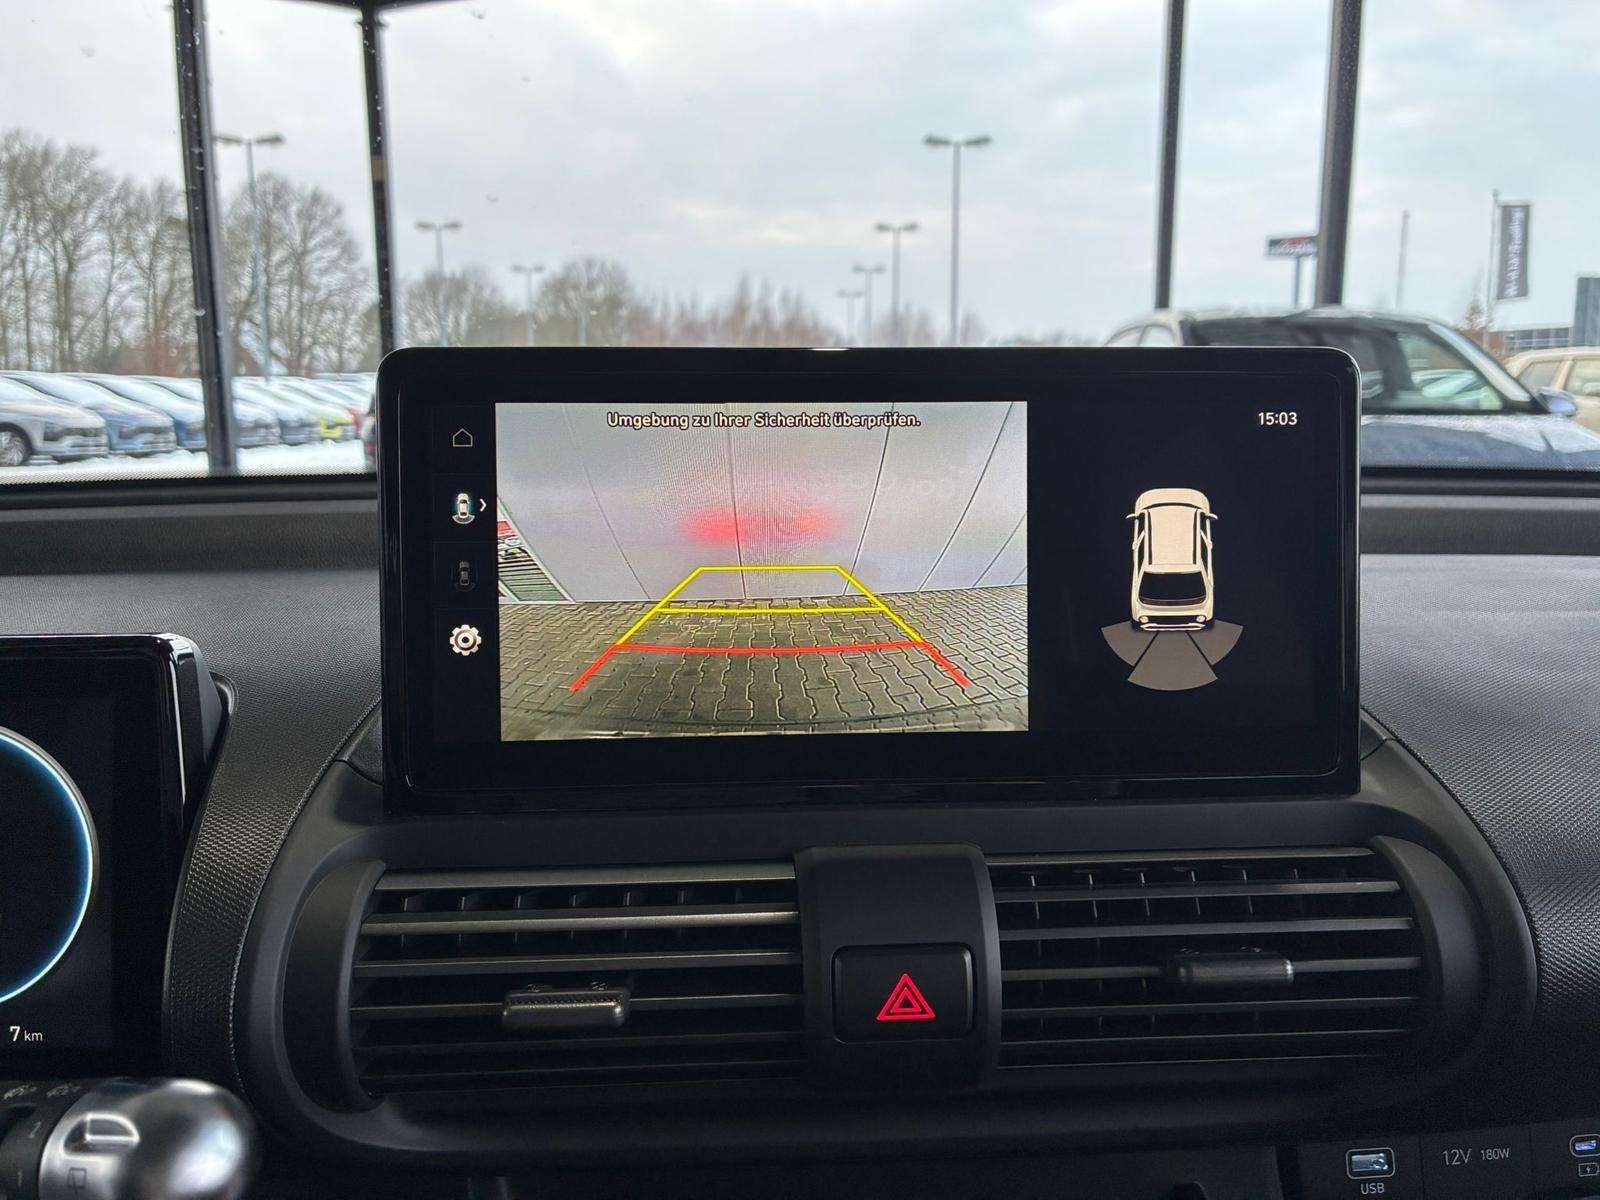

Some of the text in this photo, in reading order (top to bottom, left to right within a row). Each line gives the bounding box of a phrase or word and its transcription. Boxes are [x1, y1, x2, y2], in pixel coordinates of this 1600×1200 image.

[607, 412, 921, 429] Umgebung zu Ihrer Sicherheit überprüfen.
[1258, 411, 1298, 426] 15:03
[9, 1025, 43, 1041] 7 km
[1442, 1148, 1510, 1166] 12V 180W
[1360, 1183, 1385, 1195] USB
